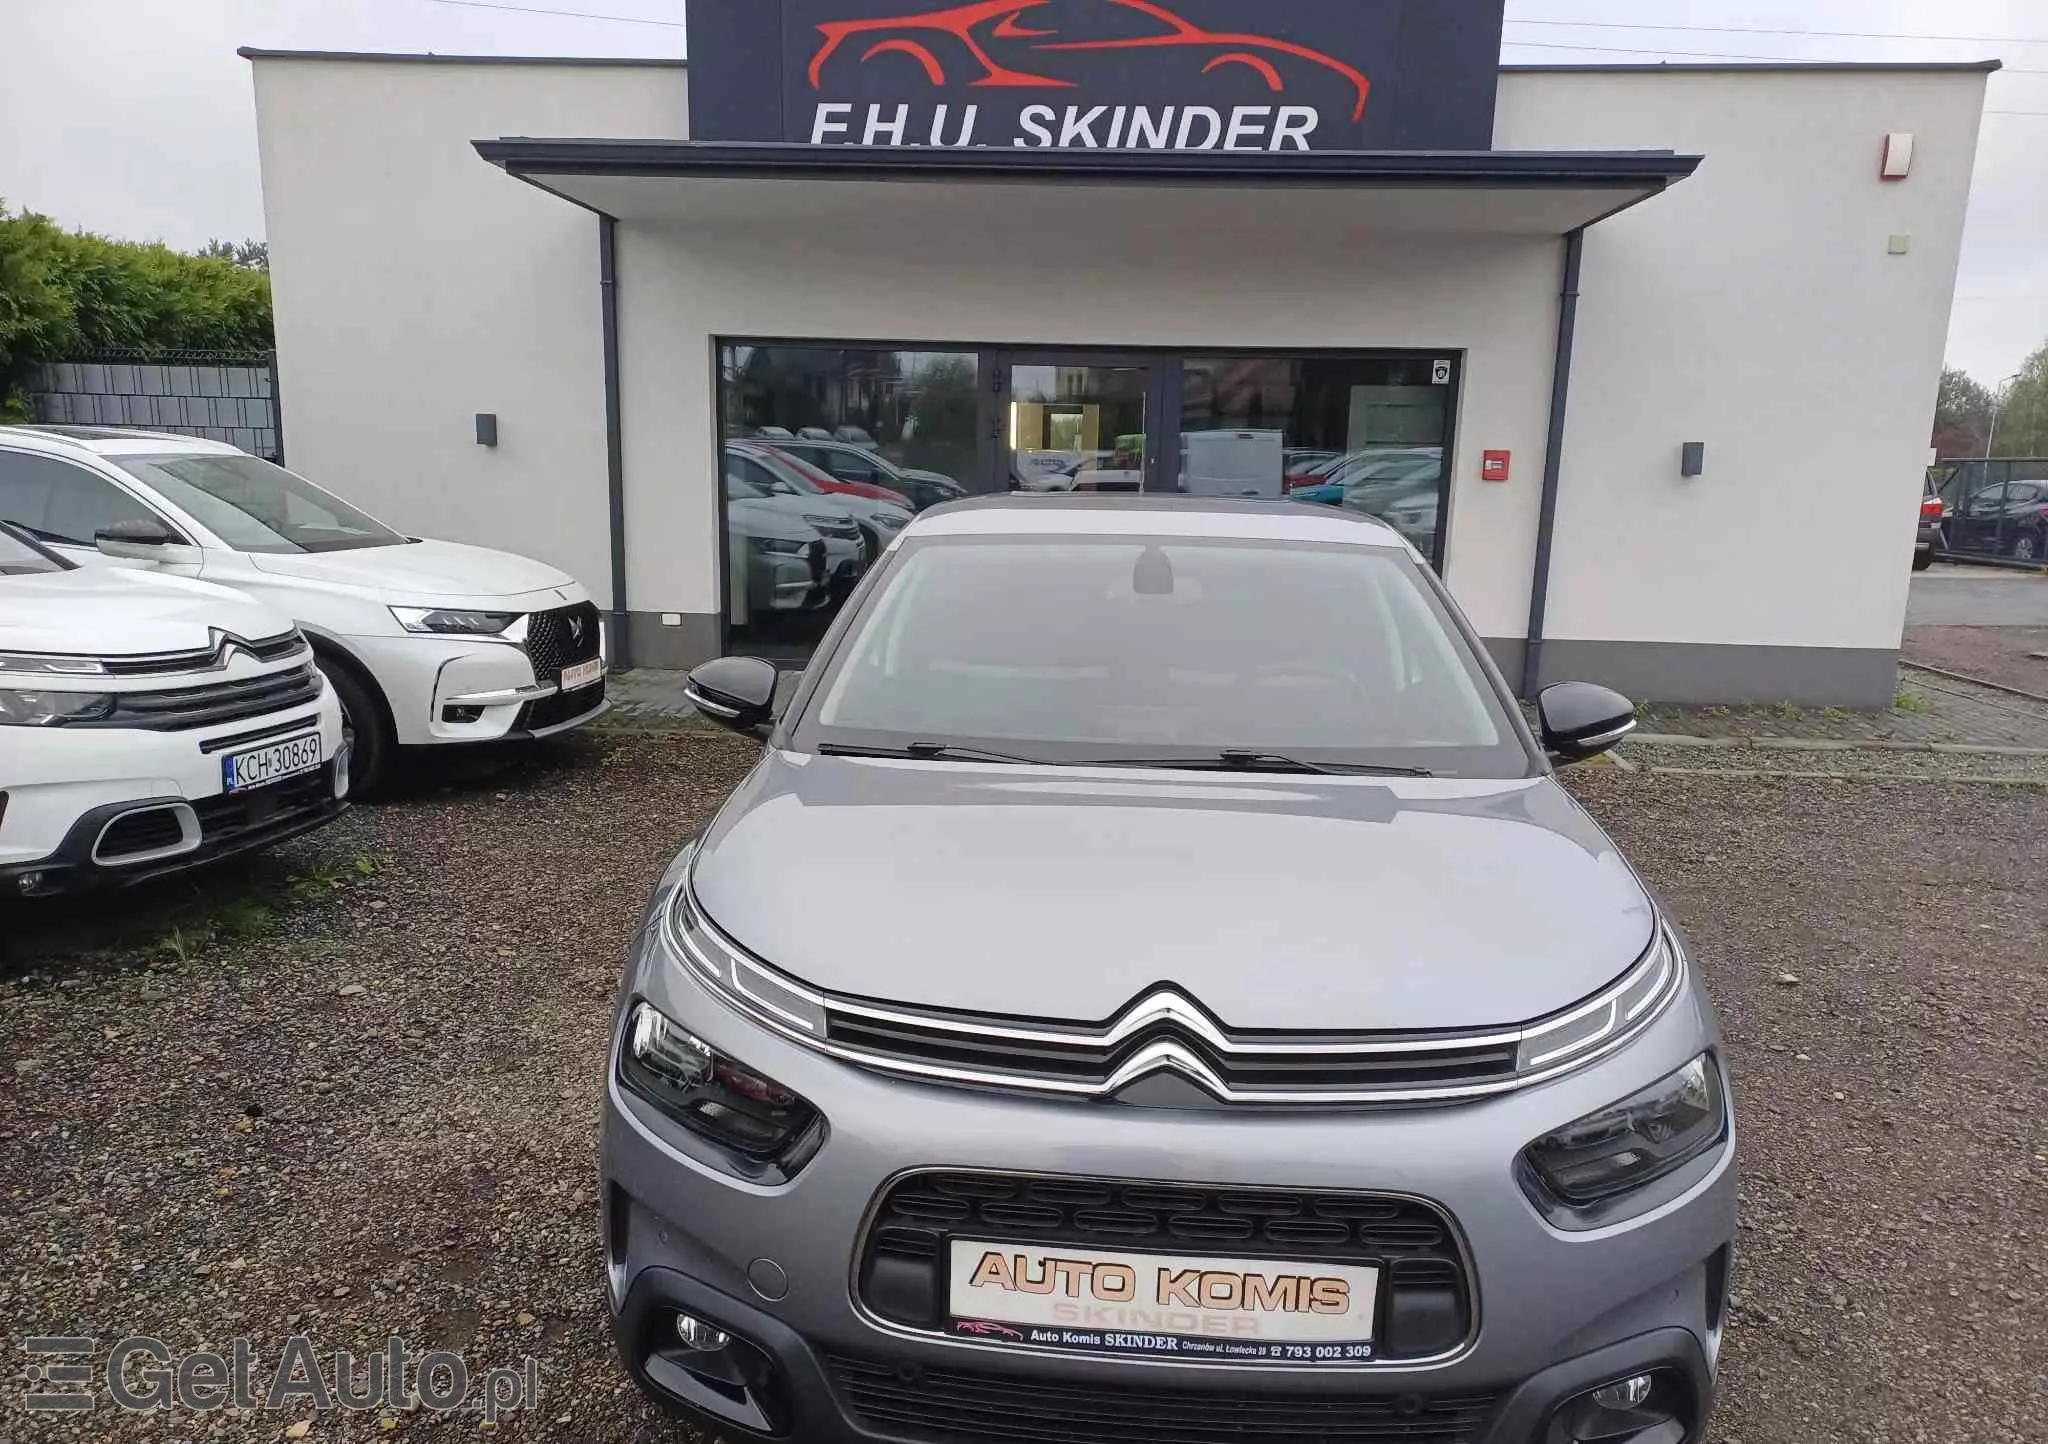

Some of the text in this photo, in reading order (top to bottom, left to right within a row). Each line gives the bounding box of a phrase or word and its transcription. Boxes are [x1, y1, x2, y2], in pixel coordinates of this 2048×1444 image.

[1013, 104, 1319, 151] SKINDER
[235, 752, 269, 785] KCH
[273, 738, 317, 773] 30869
[969, 1251, 1351, 1315] AUTO KOMIS
[1052, 1301, 1261, 1337] SKINDER
[1030, 1329, 1059, 1342] Auto
[1062, 1332, 1101, 1345] Komis
[1104, 1333, 1178, 1350] SKINDER
[1286, 1345, 1311, 1358] 793
[1315, 1346, 1342, 1358] 002
[1345, 1345, 1371, 1357] 309
